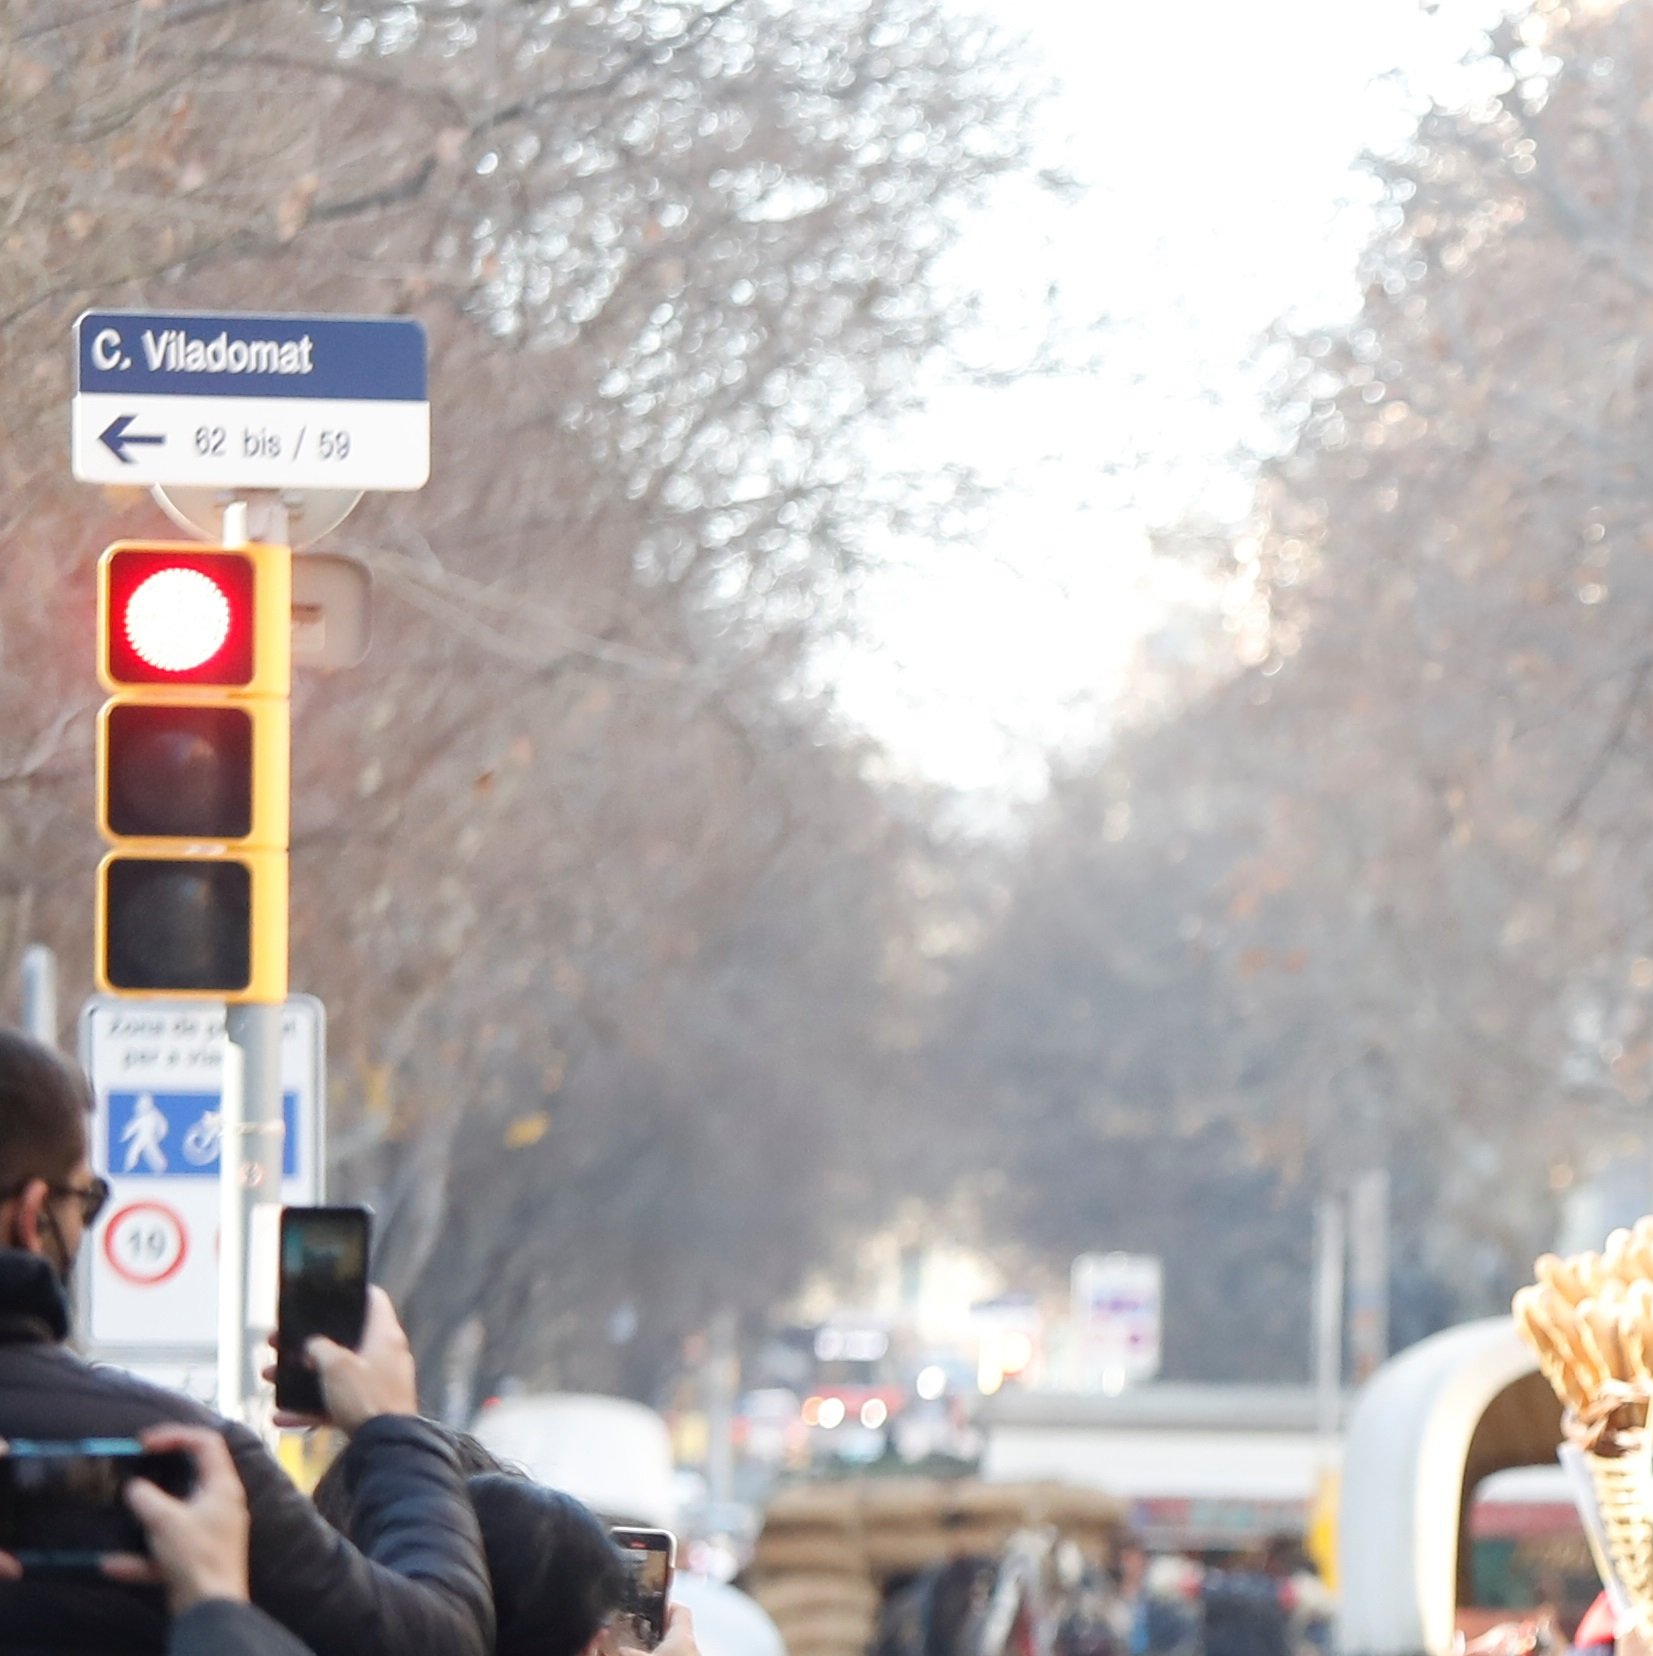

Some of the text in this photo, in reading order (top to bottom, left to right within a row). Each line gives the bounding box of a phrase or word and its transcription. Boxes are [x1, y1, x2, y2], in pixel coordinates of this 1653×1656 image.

[91, 328, 314, 375] C. Viladomat
[195, 427, 227, 457] 62
[242, 427, 281, 458] bis
[318, 430, 351, 461] 59
[129, 1229, 167, 1260] 10
